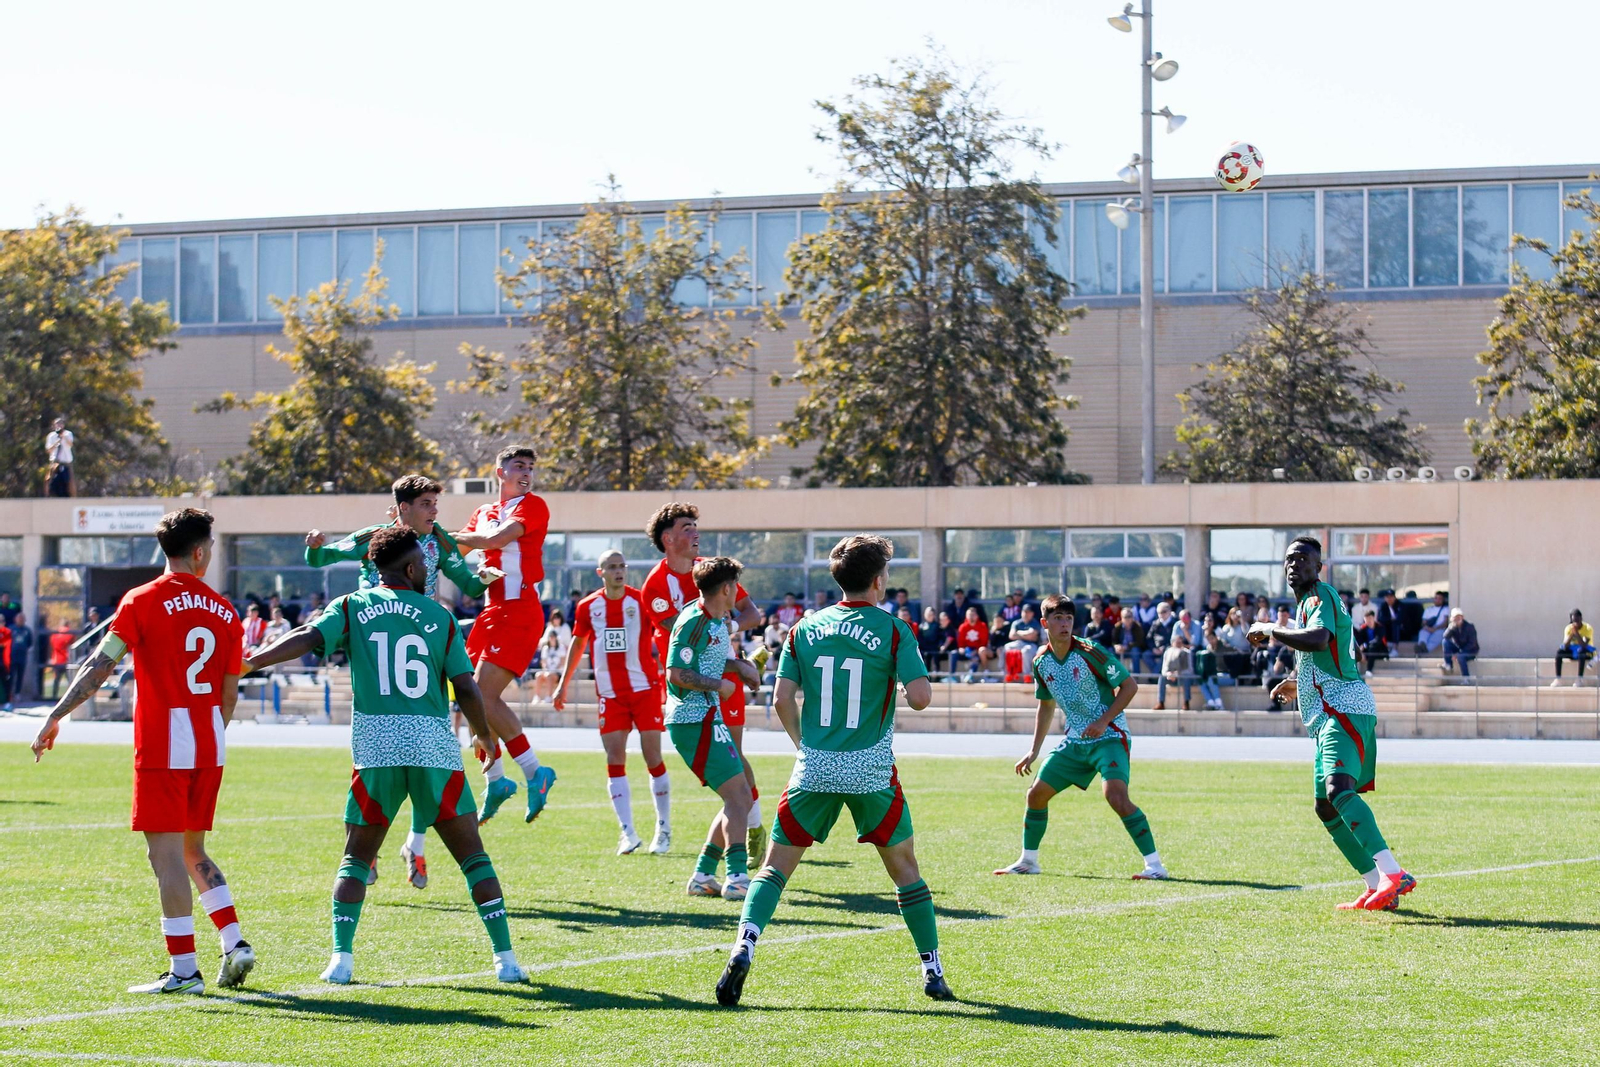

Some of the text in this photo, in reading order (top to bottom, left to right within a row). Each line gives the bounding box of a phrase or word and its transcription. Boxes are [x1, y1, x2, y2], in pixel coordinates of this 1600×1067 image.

[163, 591, 233, 624] PEÑALVER
[423, 622, 439, 634] J
[609, 632, 621, 640] DA
[185, 626, 216, 695] 2
[368, 631, 429, 699] 16
[813, 655, 863, 729] 11
[713, 723, 732, 744] 46
